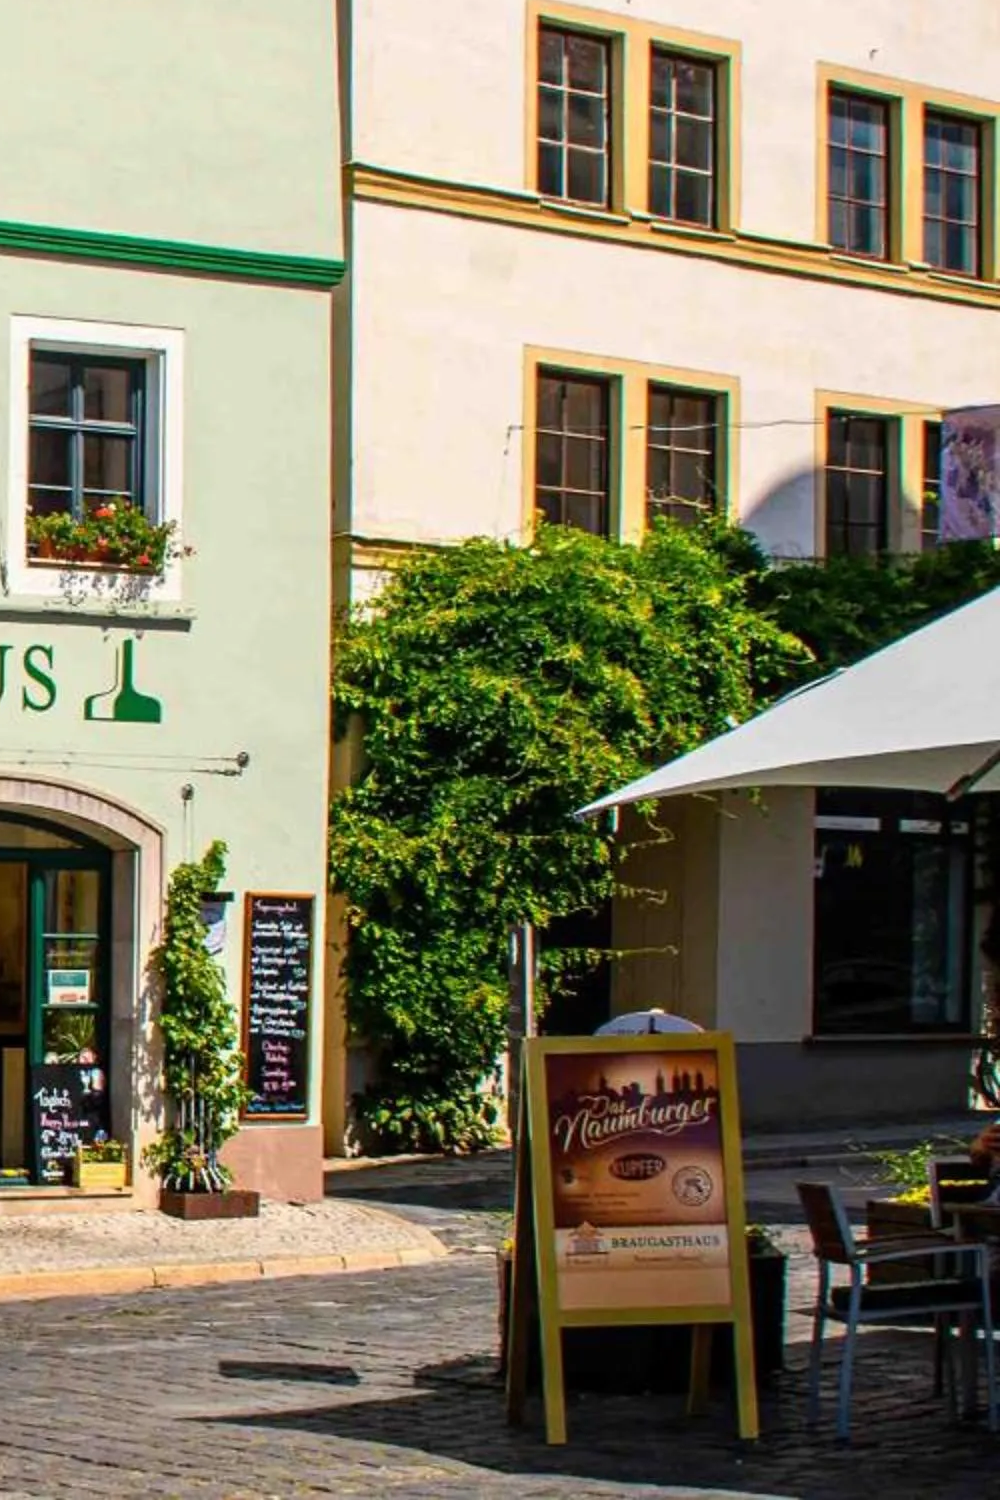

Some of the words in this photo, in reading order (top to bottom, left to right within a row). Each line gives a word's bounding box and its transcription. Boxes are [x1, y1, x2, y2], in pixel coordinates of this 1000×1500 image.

[578, 1094, 626, 1119] Das
[554, 1095, 718, 1153] Naumburger
[611, 1235, 721, 1249] BRAUGASTHAUS
